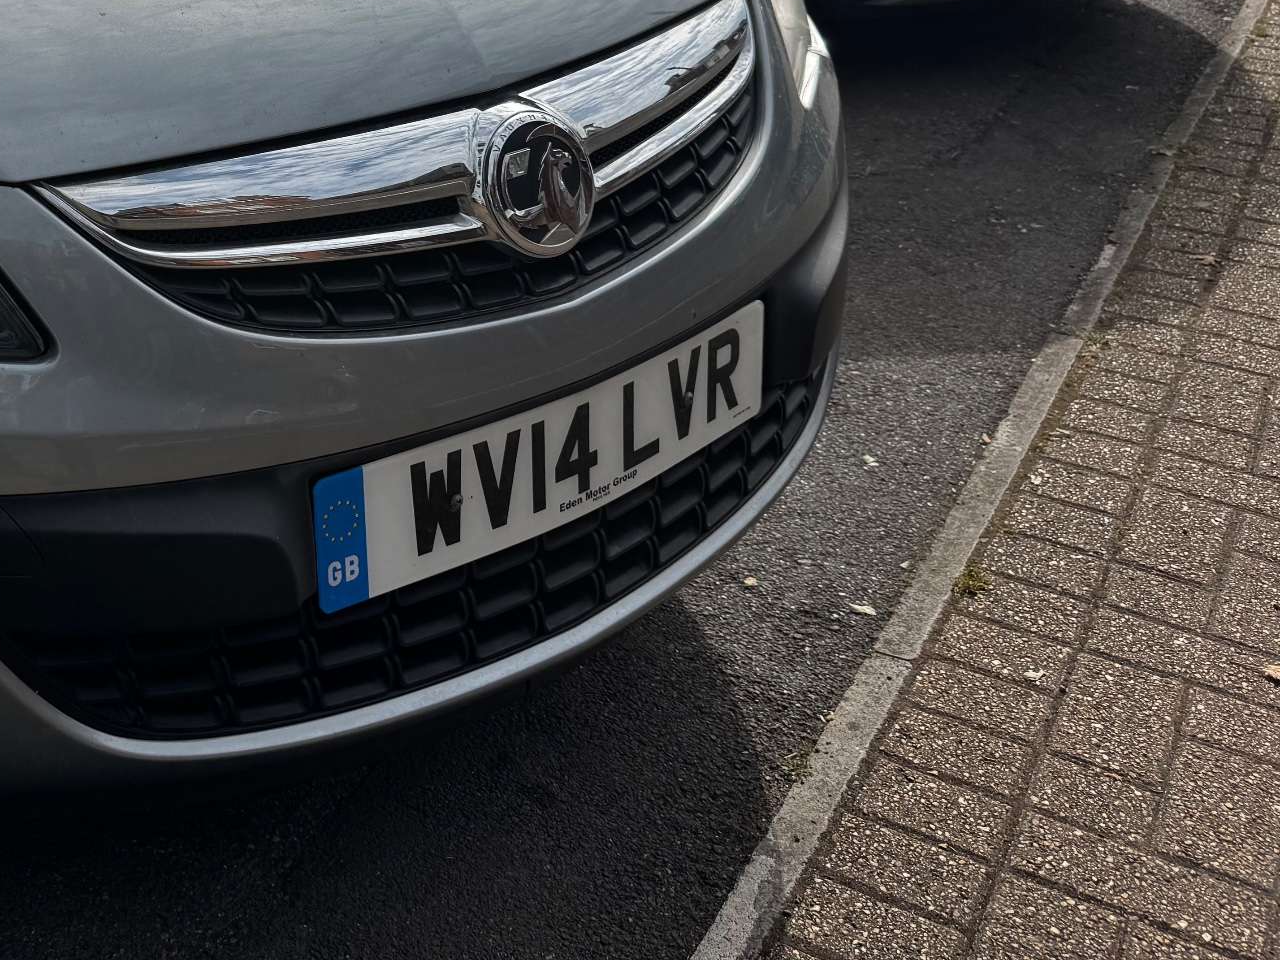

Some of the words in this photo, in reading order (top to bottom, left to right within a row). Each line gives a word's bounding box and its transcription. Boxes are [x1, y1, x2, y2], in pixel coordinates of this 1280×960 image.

[409, 401, 598, 557] WV14
[623, 327, 741, 473] LVR
[559, 496, 583, 513] Eden
[585, 481, 612, 502] Motor
[612, 467, 638, 488] Group
[326, 553, 361, 588] GB
